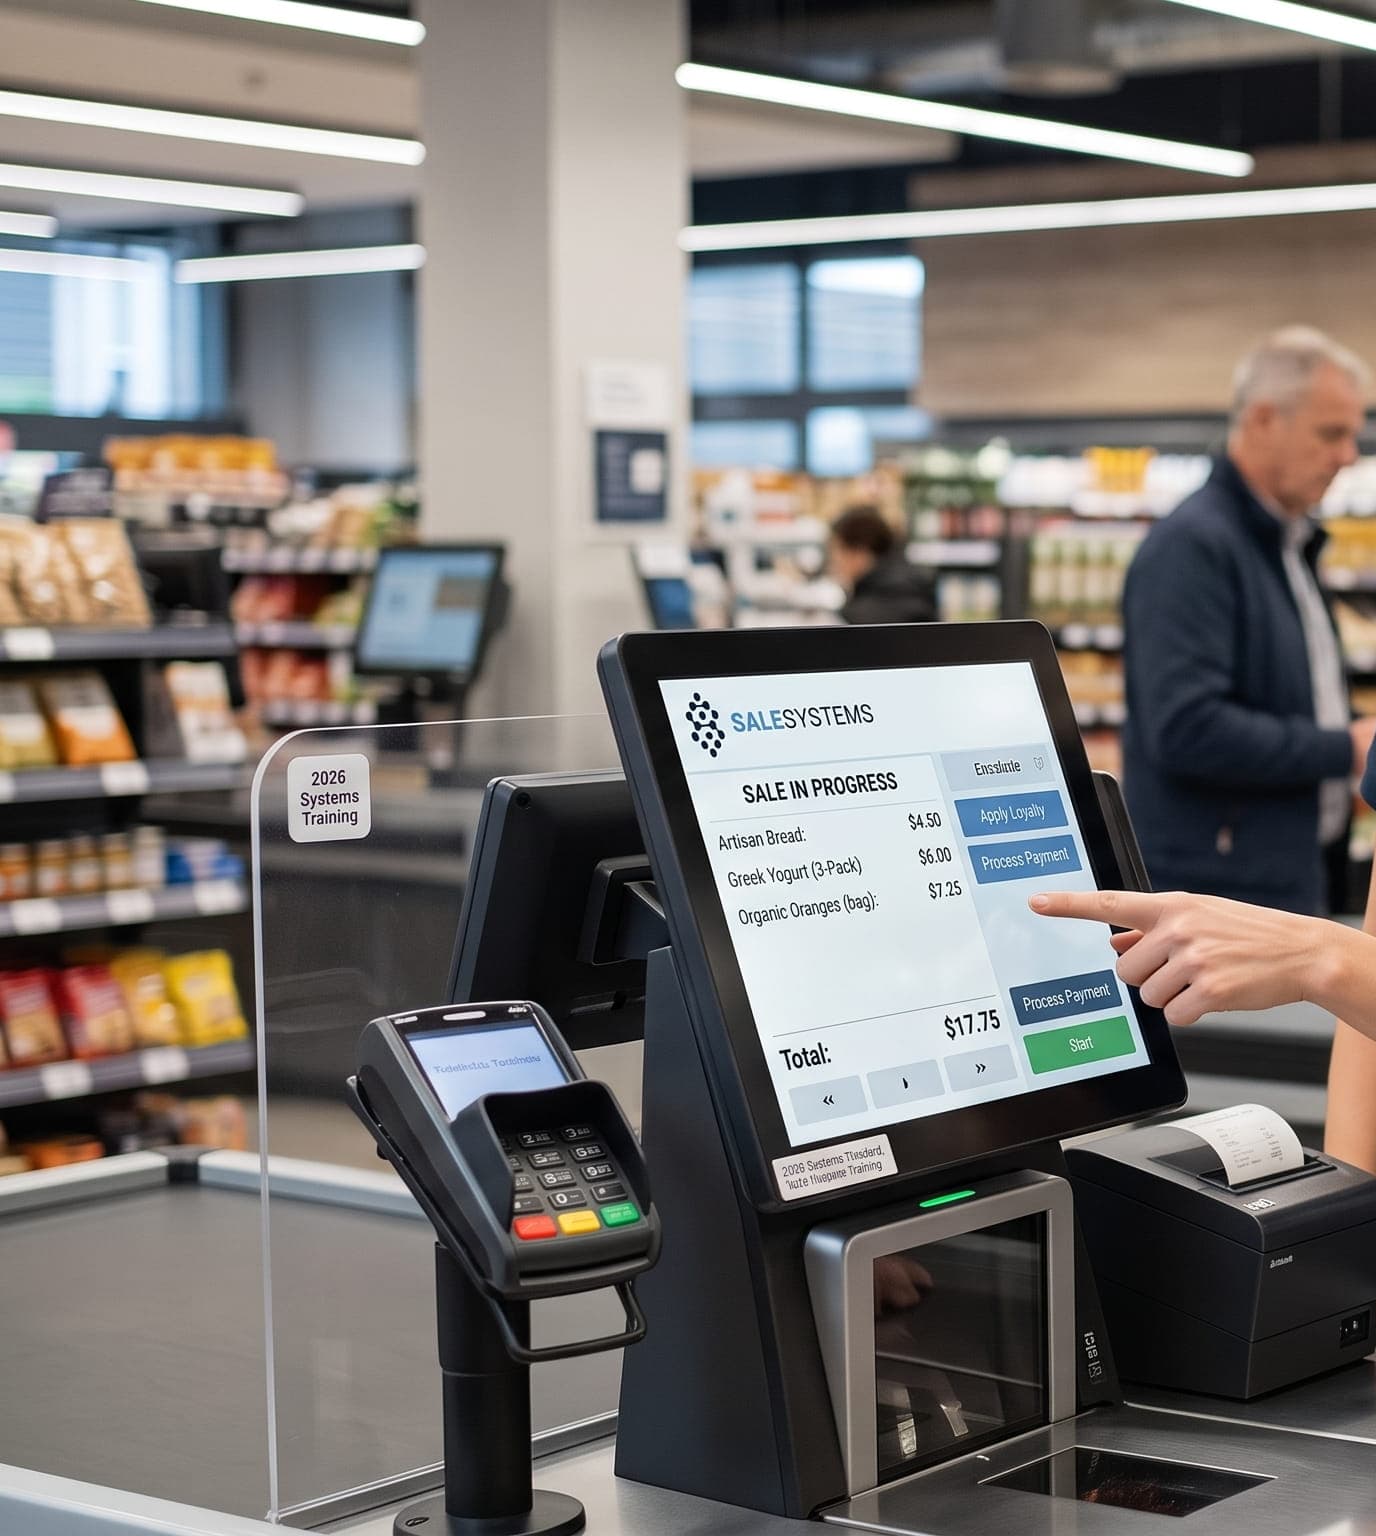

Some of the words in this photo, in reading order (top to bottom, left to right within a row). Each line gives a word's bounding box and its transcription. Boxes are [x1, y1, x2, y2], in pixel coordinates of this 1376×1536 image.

[730, 704, 874, 733] SALESYSTEMS
[311, 769, 346, 786] 2026
[742, 782, 788, 804] SALE
[790, 779, 809, 799] IN
[811, 771, 898, 797] PROGRESS
[300, 791, 360, 810] Systems
[301, 808, 359, 826] Training
[980, 807, 1009, 826] Apply
[718, 833, 765, 851] Artisan
[766, 826, 807, 846] Bread:
[908, 812, 942, 831] $4.50
[727, 867, 766, 888] Greek
[767, 863, 810, 885] Yogurt
[811, 855, 863, 881] (3-Pack)
[918, 846, 952, 867] $6.00
[981, 852, 1024, 871] Process
[1024, 847, 1070, 867] Payment
[738, 905, 788, 927] Organic
[789, 897, 841, 918] Oranges
[843, 890, 880, 914] (bag):
[928, 880, 962, 900] $7.25
[1023, 992, 1064, 1012] Process
[1065, 983, 1111, 1005] Payment
[779, 1041, 832, 1071] Total:
[943, 1009, 1001, 1041] $17.75
[1069, 1036, 1094, 1053] Start
[544, 1173, 557, 1184] 8
[848, 1161, 883, 1176] Training
